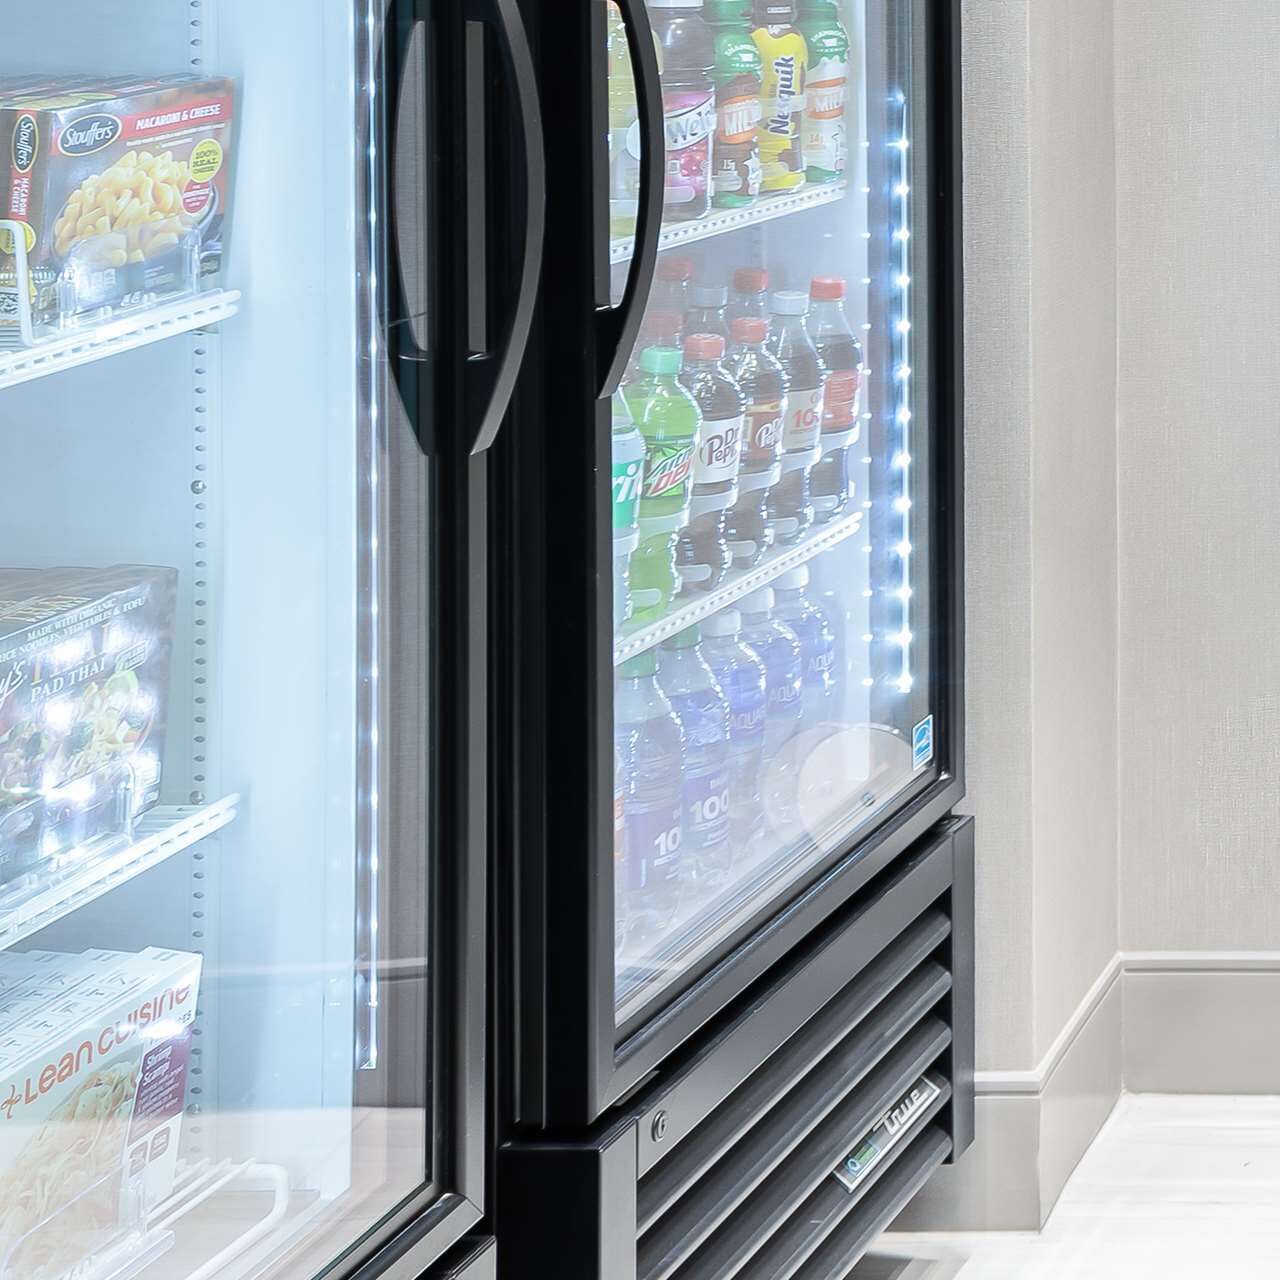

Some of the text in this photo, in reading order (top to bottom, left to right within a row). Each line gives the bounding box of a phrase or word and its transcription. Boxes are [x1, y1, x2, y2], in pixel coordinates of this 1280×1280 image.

[16, 120, 34, 167] Stouffer's
[63, 120, 115, 149] Stouffer's
[31, 657, 106, 704] PAD THAI
[25, 1040, 93, 1105] Lean
